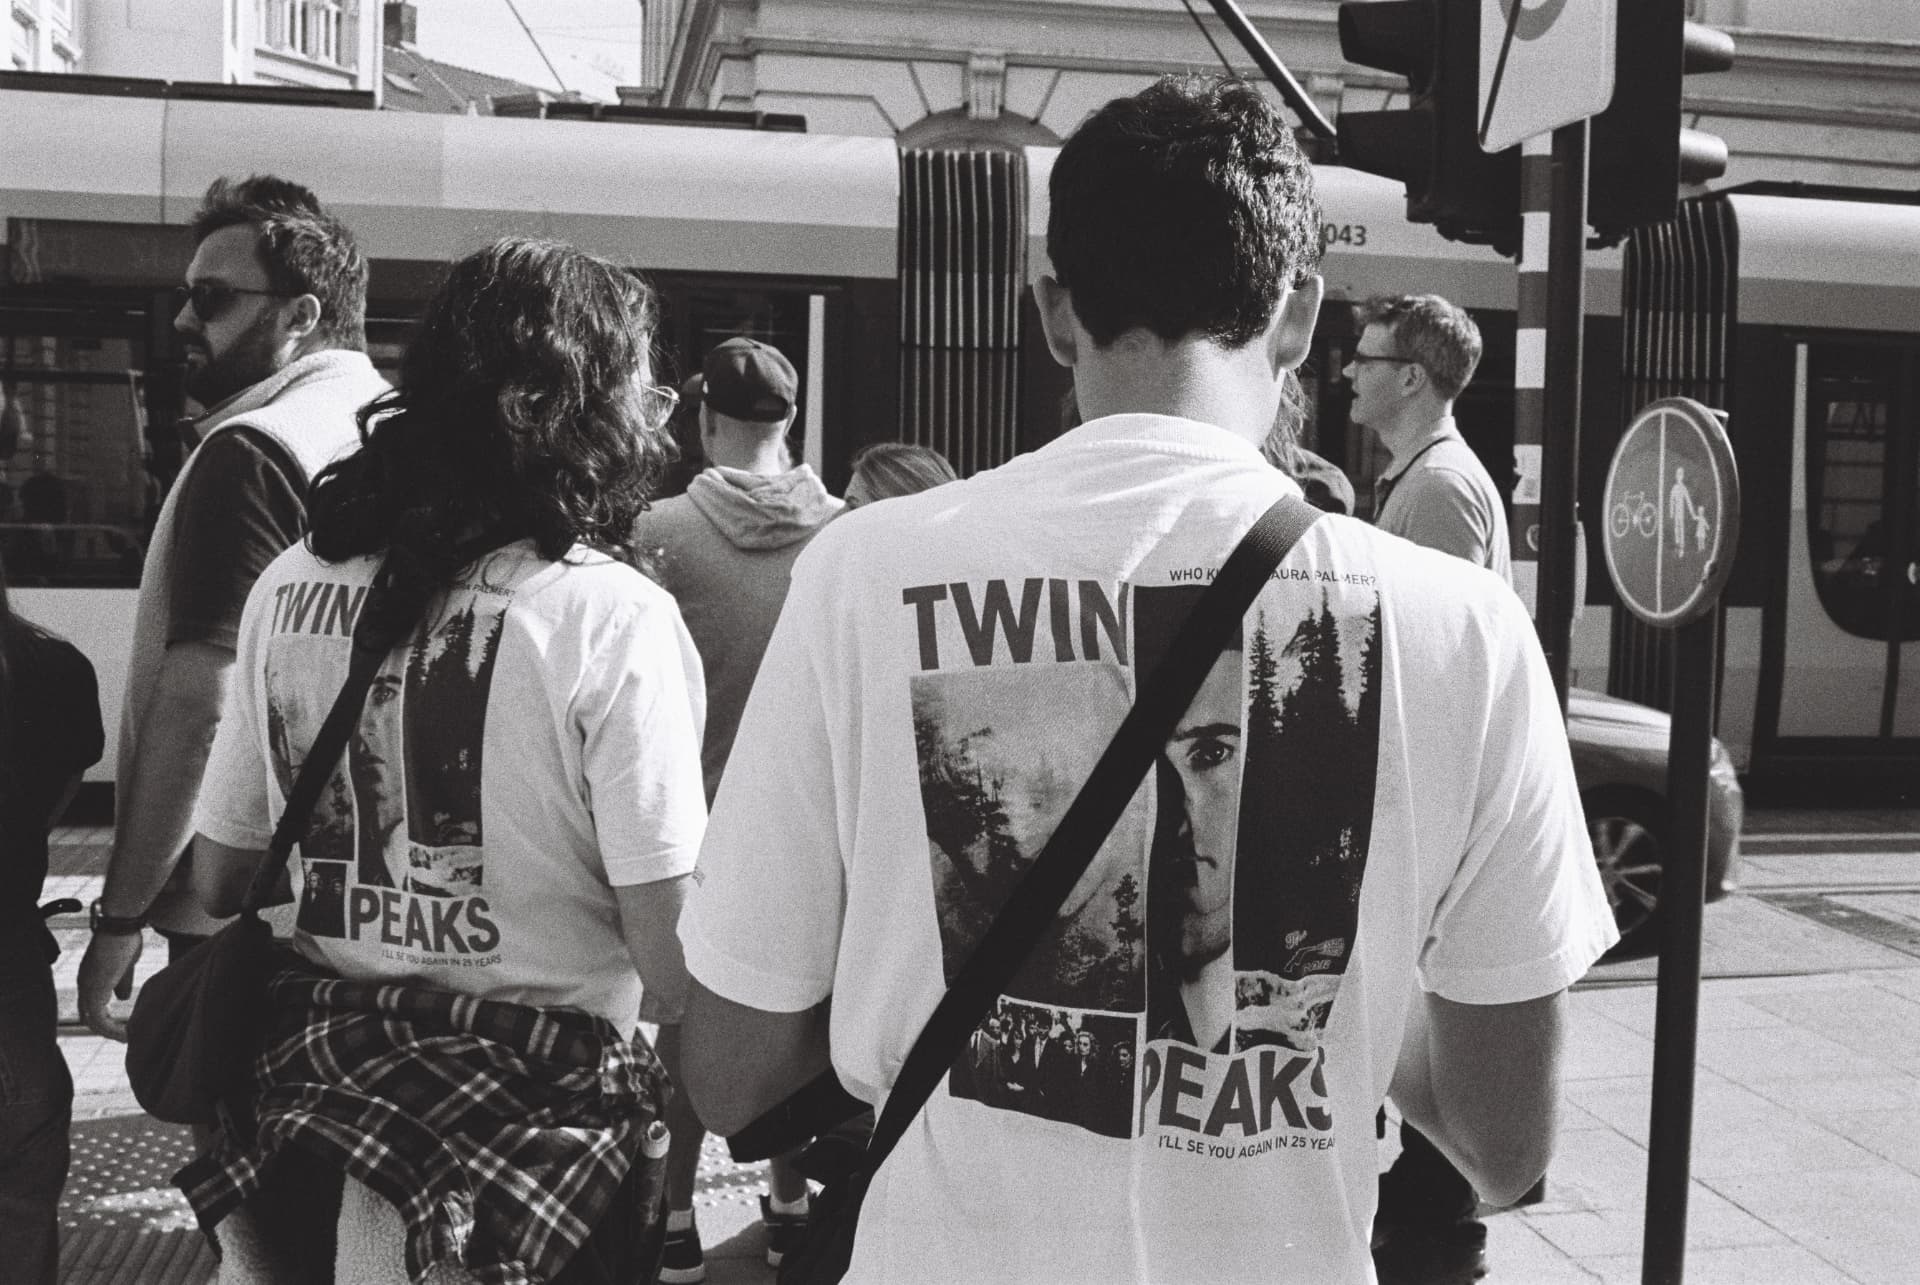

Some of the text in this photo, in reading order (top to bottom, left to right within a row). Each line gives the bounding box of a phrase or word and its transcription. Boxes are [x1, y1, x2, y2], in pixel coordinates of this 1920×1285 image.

[1320, 223, 1367, 246] 043
[1169, 567, 1203, 581] WHO
[1271, 569, 1310, 581] AURA
[271, 582, 369, 637] TWIN
[902, 578, 1129, 671] TWIN
[351, 887, 500, 953] PEAKS
[1139, 1046, 1333, 1137] PEAKS
[1158, 1135, 1334, 1159] I'LL SE YOU AGAIN IN 25 YEA
